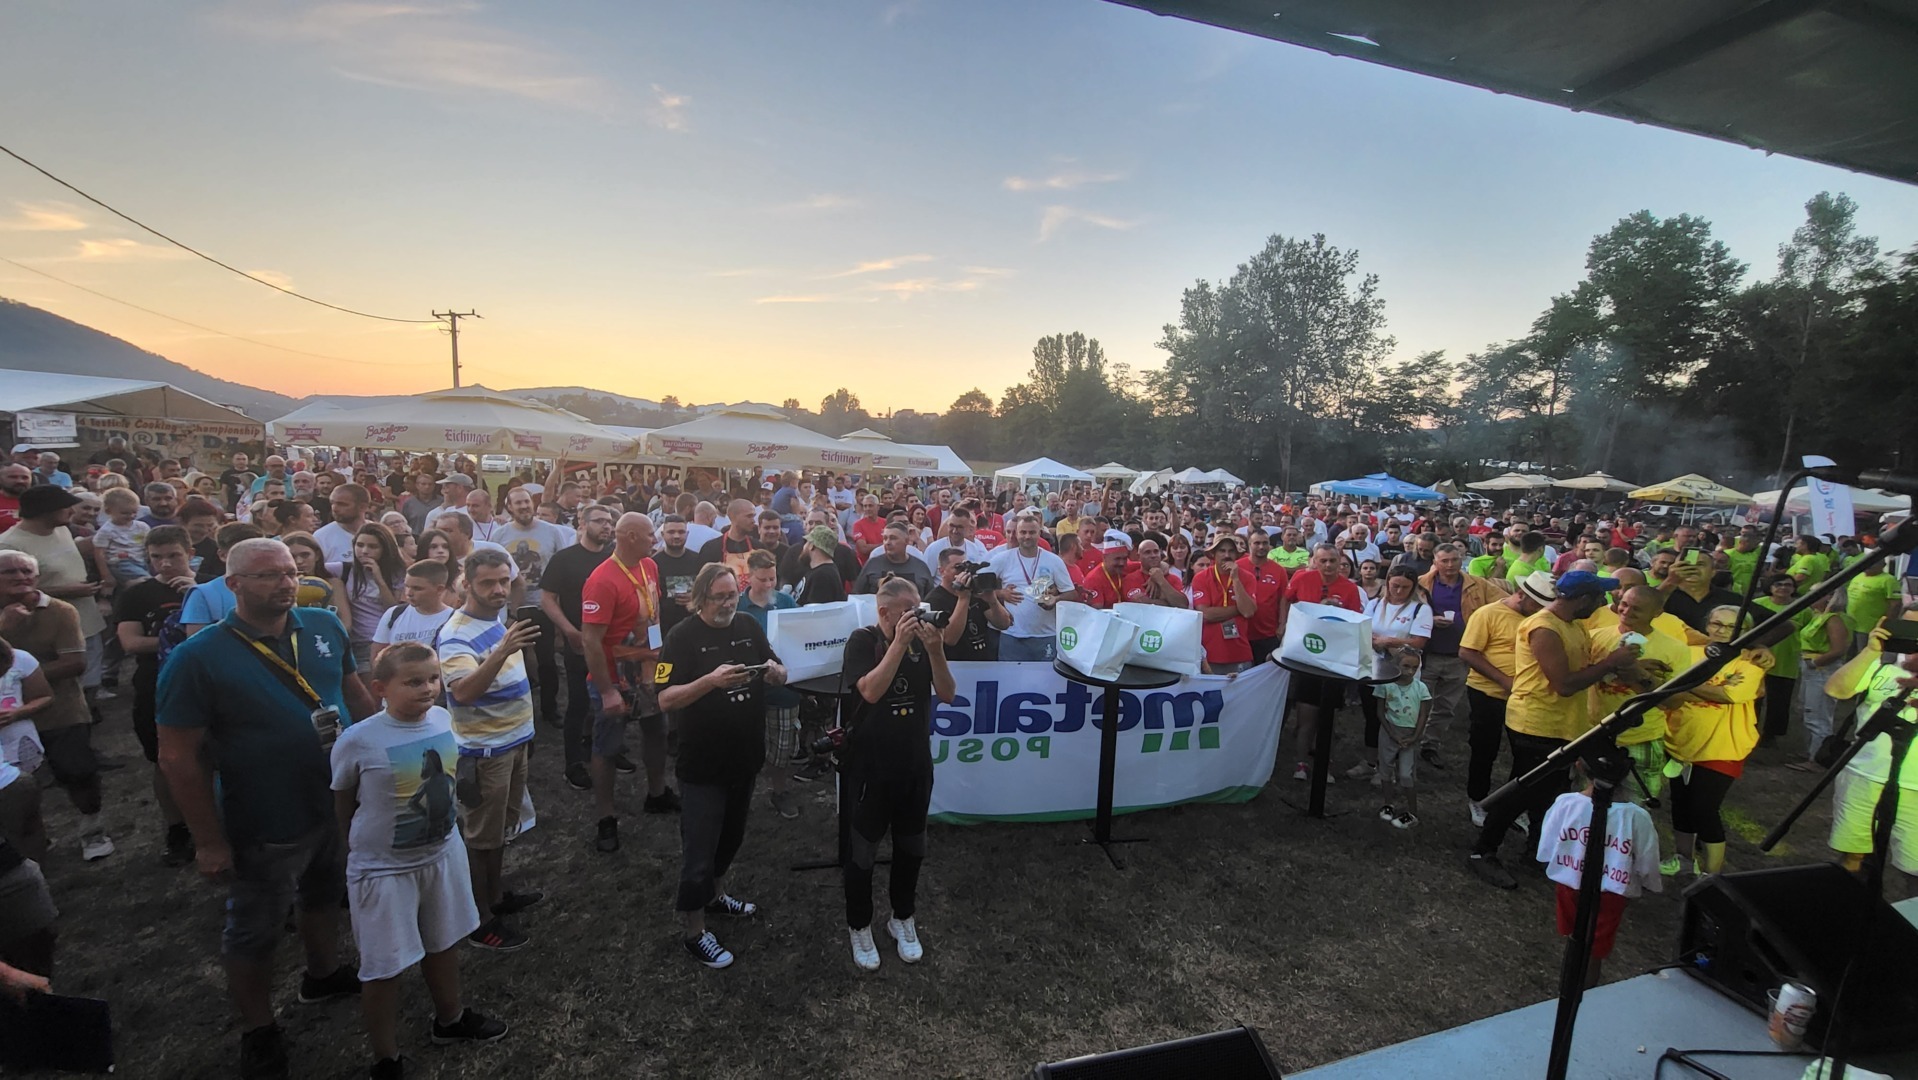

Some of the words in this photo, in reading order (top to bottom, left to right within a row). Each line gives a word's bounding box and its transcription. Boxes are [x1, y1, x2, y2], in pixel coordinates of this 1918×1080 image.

[134, 419, 177, 432] Cooking
[444, 429, 491, 445] Eichinger
[820, 449, 863, 465] Eichinger
[804, 637, 847, 649] metalac
